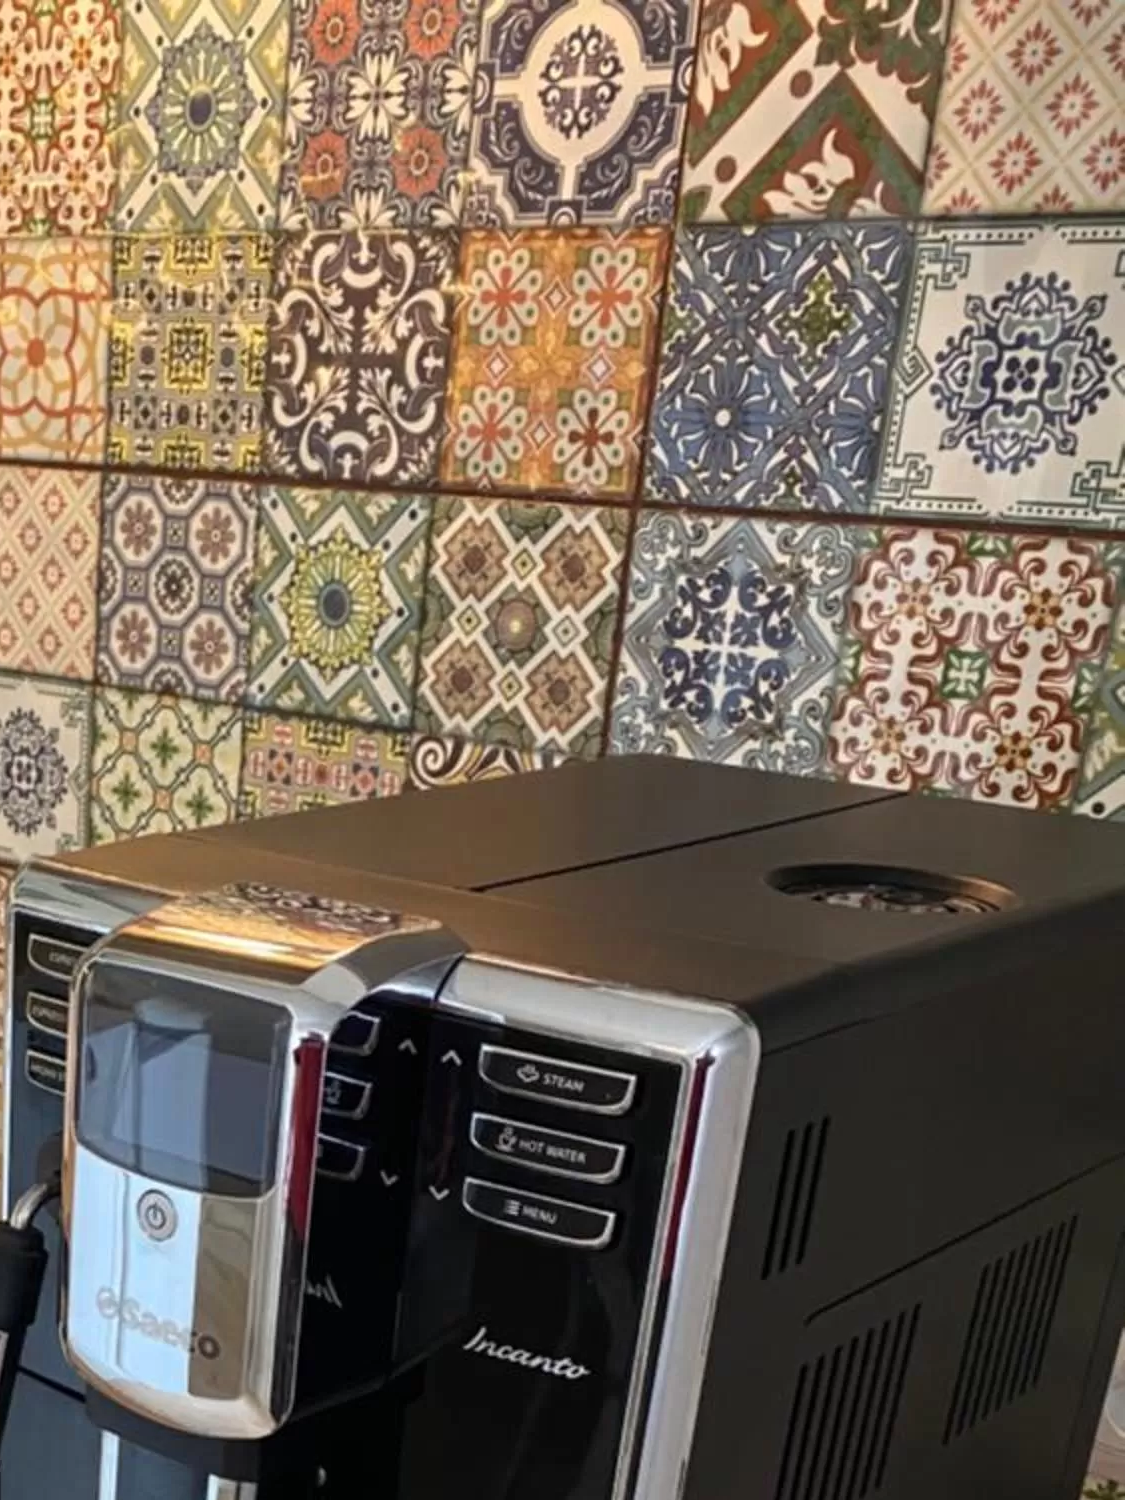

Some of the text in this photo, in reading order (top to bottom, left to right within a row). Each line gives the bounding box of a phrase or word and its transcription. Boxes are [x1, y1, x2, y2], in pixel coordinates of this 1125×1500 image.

[543, 1073, 585, 1093] STEAM
[519, 1139, 586, 1164] HOT WATER
[522, 1205, 557, 1225] MENU
[464, 1326, 590, 1379] Incanto
